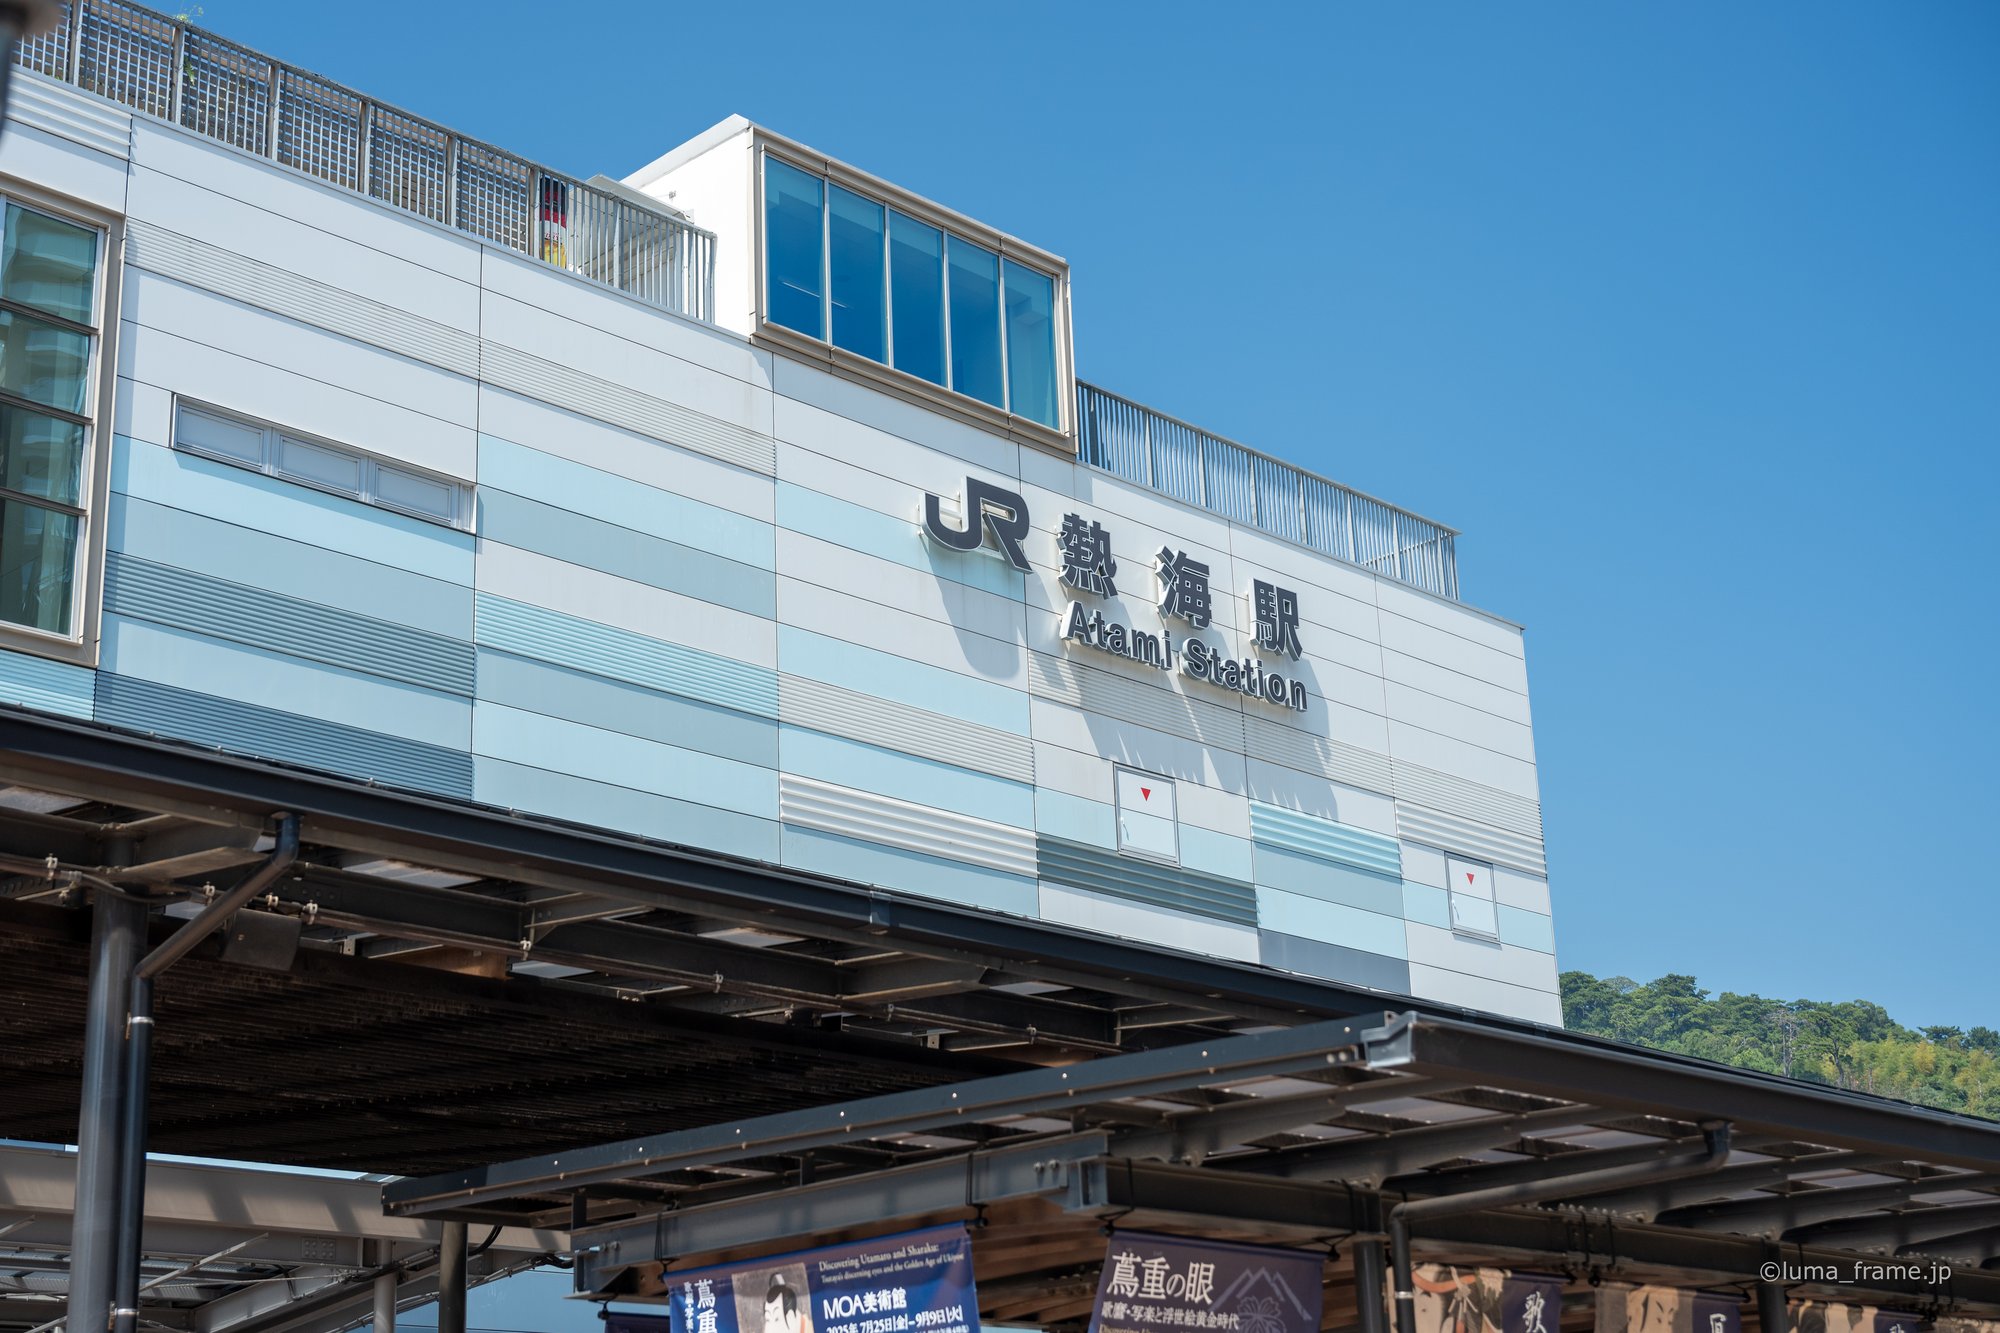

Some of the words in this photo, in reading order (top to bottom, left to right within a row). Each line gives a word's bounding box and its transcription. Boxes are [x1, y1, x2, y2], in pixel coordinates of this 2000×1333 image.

[920, 475, 1033, 574] JR
[1057, 511, 1303, 661] 熱海駅
[1060, 600, 1172, 671] Atami
[1180, 637, 1308, 712] Station
[819, 1257, 860, 1271] Discovering
[860, 1253, 891, 1265] Utamaro
[893, 1246, 906, 1259] and
[883, 1262, 893, 1273] and
[894, 1261, 904, 1272] the
[903, 1258, 924, 1269] Golden
[925, 1257, 936, 1268] Age
[1106, 1251, 1215, 1305] 蔦重の眼
[823, 1286, 907, 1320] MOA美術館
